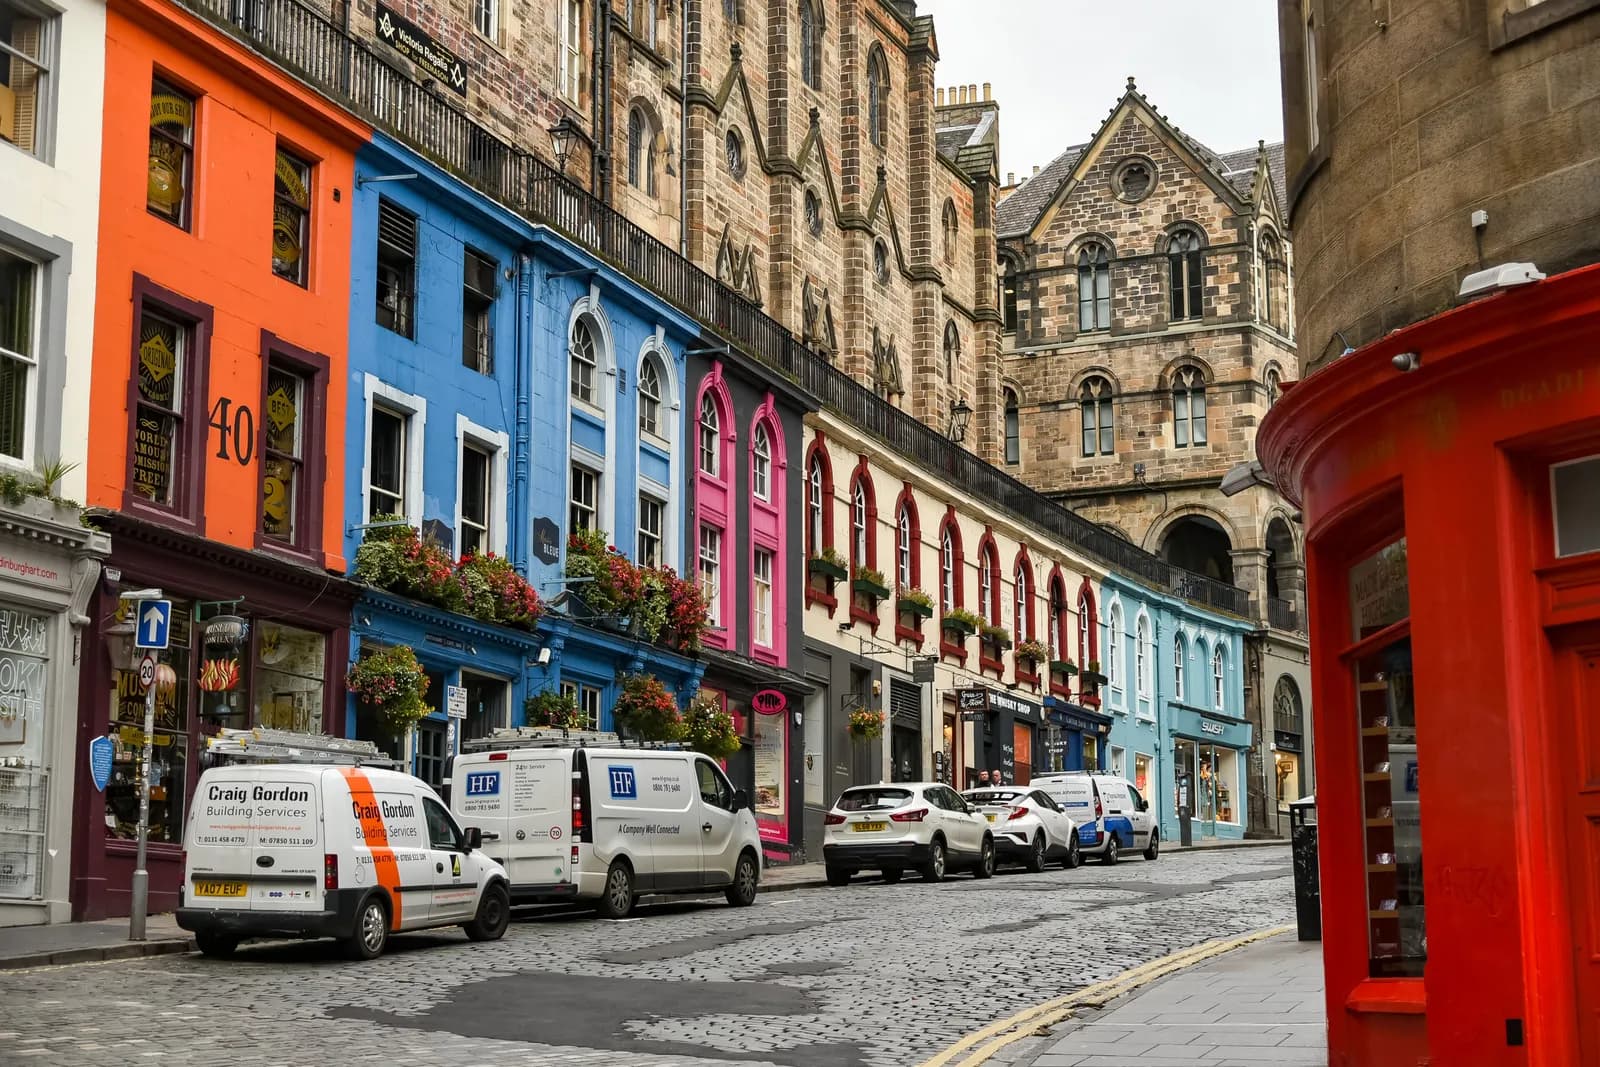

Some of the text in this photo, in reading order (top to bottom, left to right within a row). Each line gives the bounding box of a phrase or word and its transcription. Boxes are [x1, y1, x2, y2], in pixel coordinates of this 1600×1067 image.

[399, 27, 448, 72] Victoria Regalia
[271, 399, 291, 418] BEST
[208, 396, 254, 466] 40
[543, 543, 560, 559] BLEUE
[142, 665, 153, 679] 20
[997, 695, 1017, 711] WHISKY
[1017, 702, 1031, 715] SHOP
[1200, 721, 1225, 736] SWISH
[469, 775, 497, 794] HF
[611, 770, 633, 794] HF
[209, 785, 309, 804] Craig Gordon
[206, 806, 307, 819] Building Services
[352, 799, 415, 823] Craig Gordon
[355, 824, 418, 841] Building Services
[552, 829, 560, 837] 70
[623, 823, 645, 837] Company
[646, 823, 656, 834] Well
[657, 824, 680, 835] Connected
[199, 883, 243, 896] YA07 EUF
